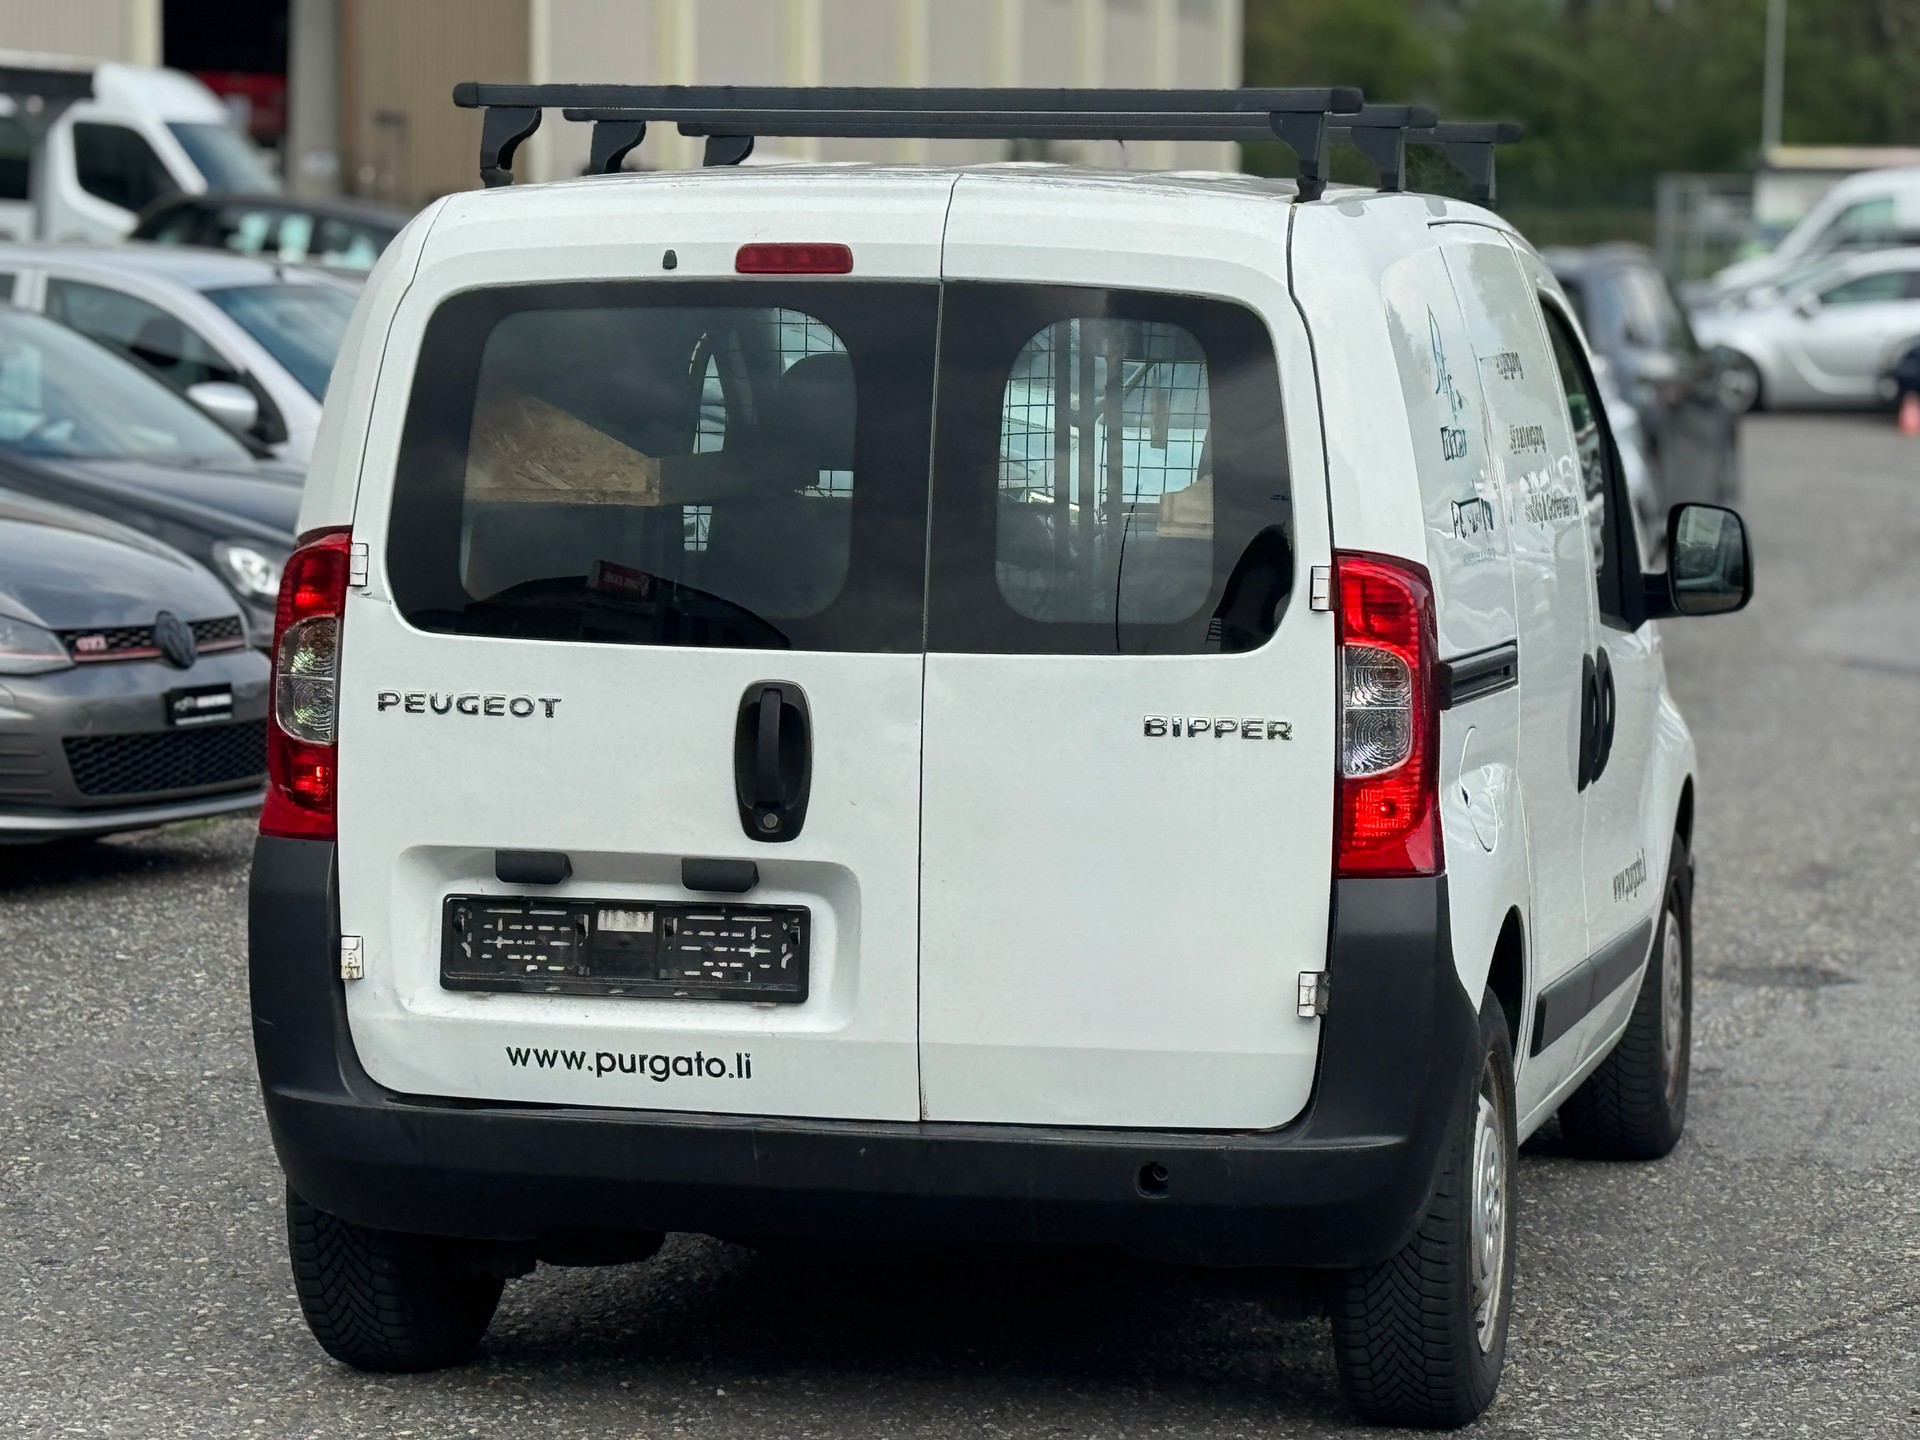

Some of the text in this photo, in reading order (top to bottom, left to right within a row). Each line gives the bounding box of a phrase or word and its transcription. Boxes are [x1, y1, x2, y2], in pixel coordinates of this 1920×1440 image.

[377, 690, 562, 718] PEUGEOT
[1143, 715, 1293, 740] BIPPER
[505, 1046, 752, 1082] www.purgato.li
